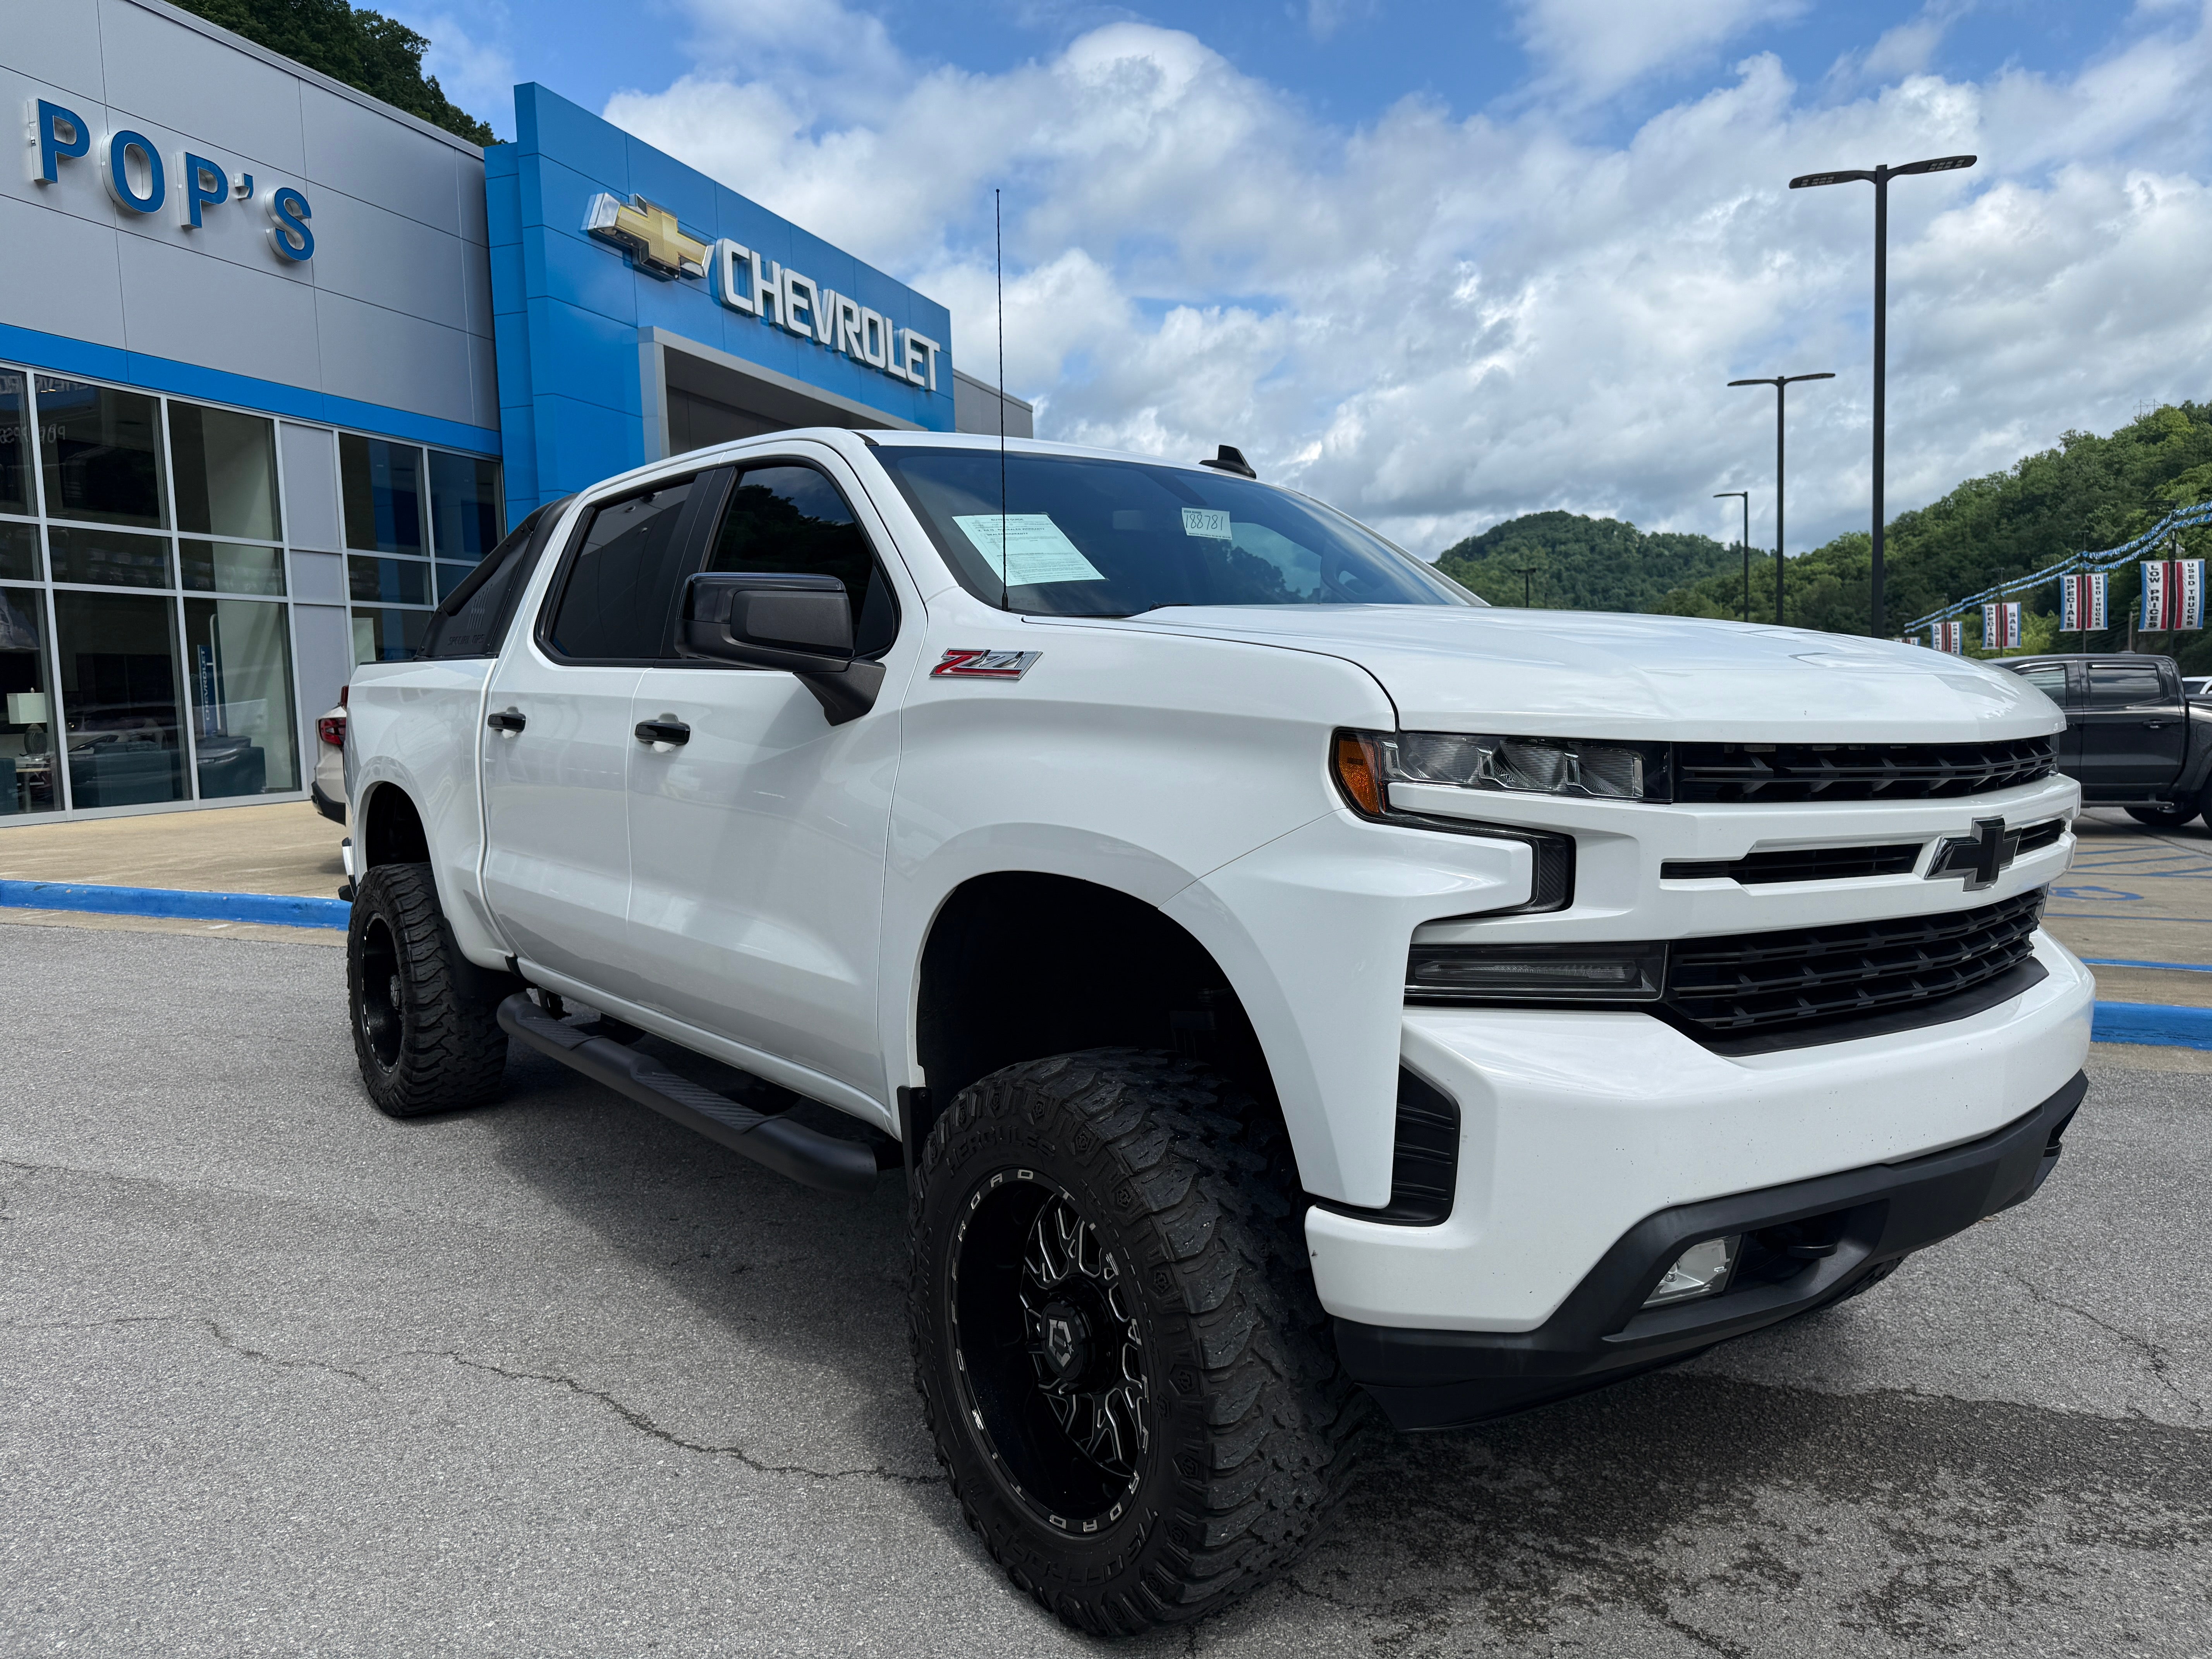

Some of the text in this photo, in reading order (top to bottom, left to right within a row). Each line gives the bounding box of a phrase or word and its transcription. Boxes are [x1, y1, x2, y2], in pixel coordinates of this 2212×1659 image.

[28, 98, 315, 262] POP'S
[717, 237, 940, 391] CHEVROLET
[1186, 514, 1223, 531] 188781
[2066, 579, 2075, 628] SPECIALS
[2148, 565, 2160, 628] LOW PRICES
[2186, 589, 2195, 625] TRUCKS
[929, 647, 1043, 680] Z71
